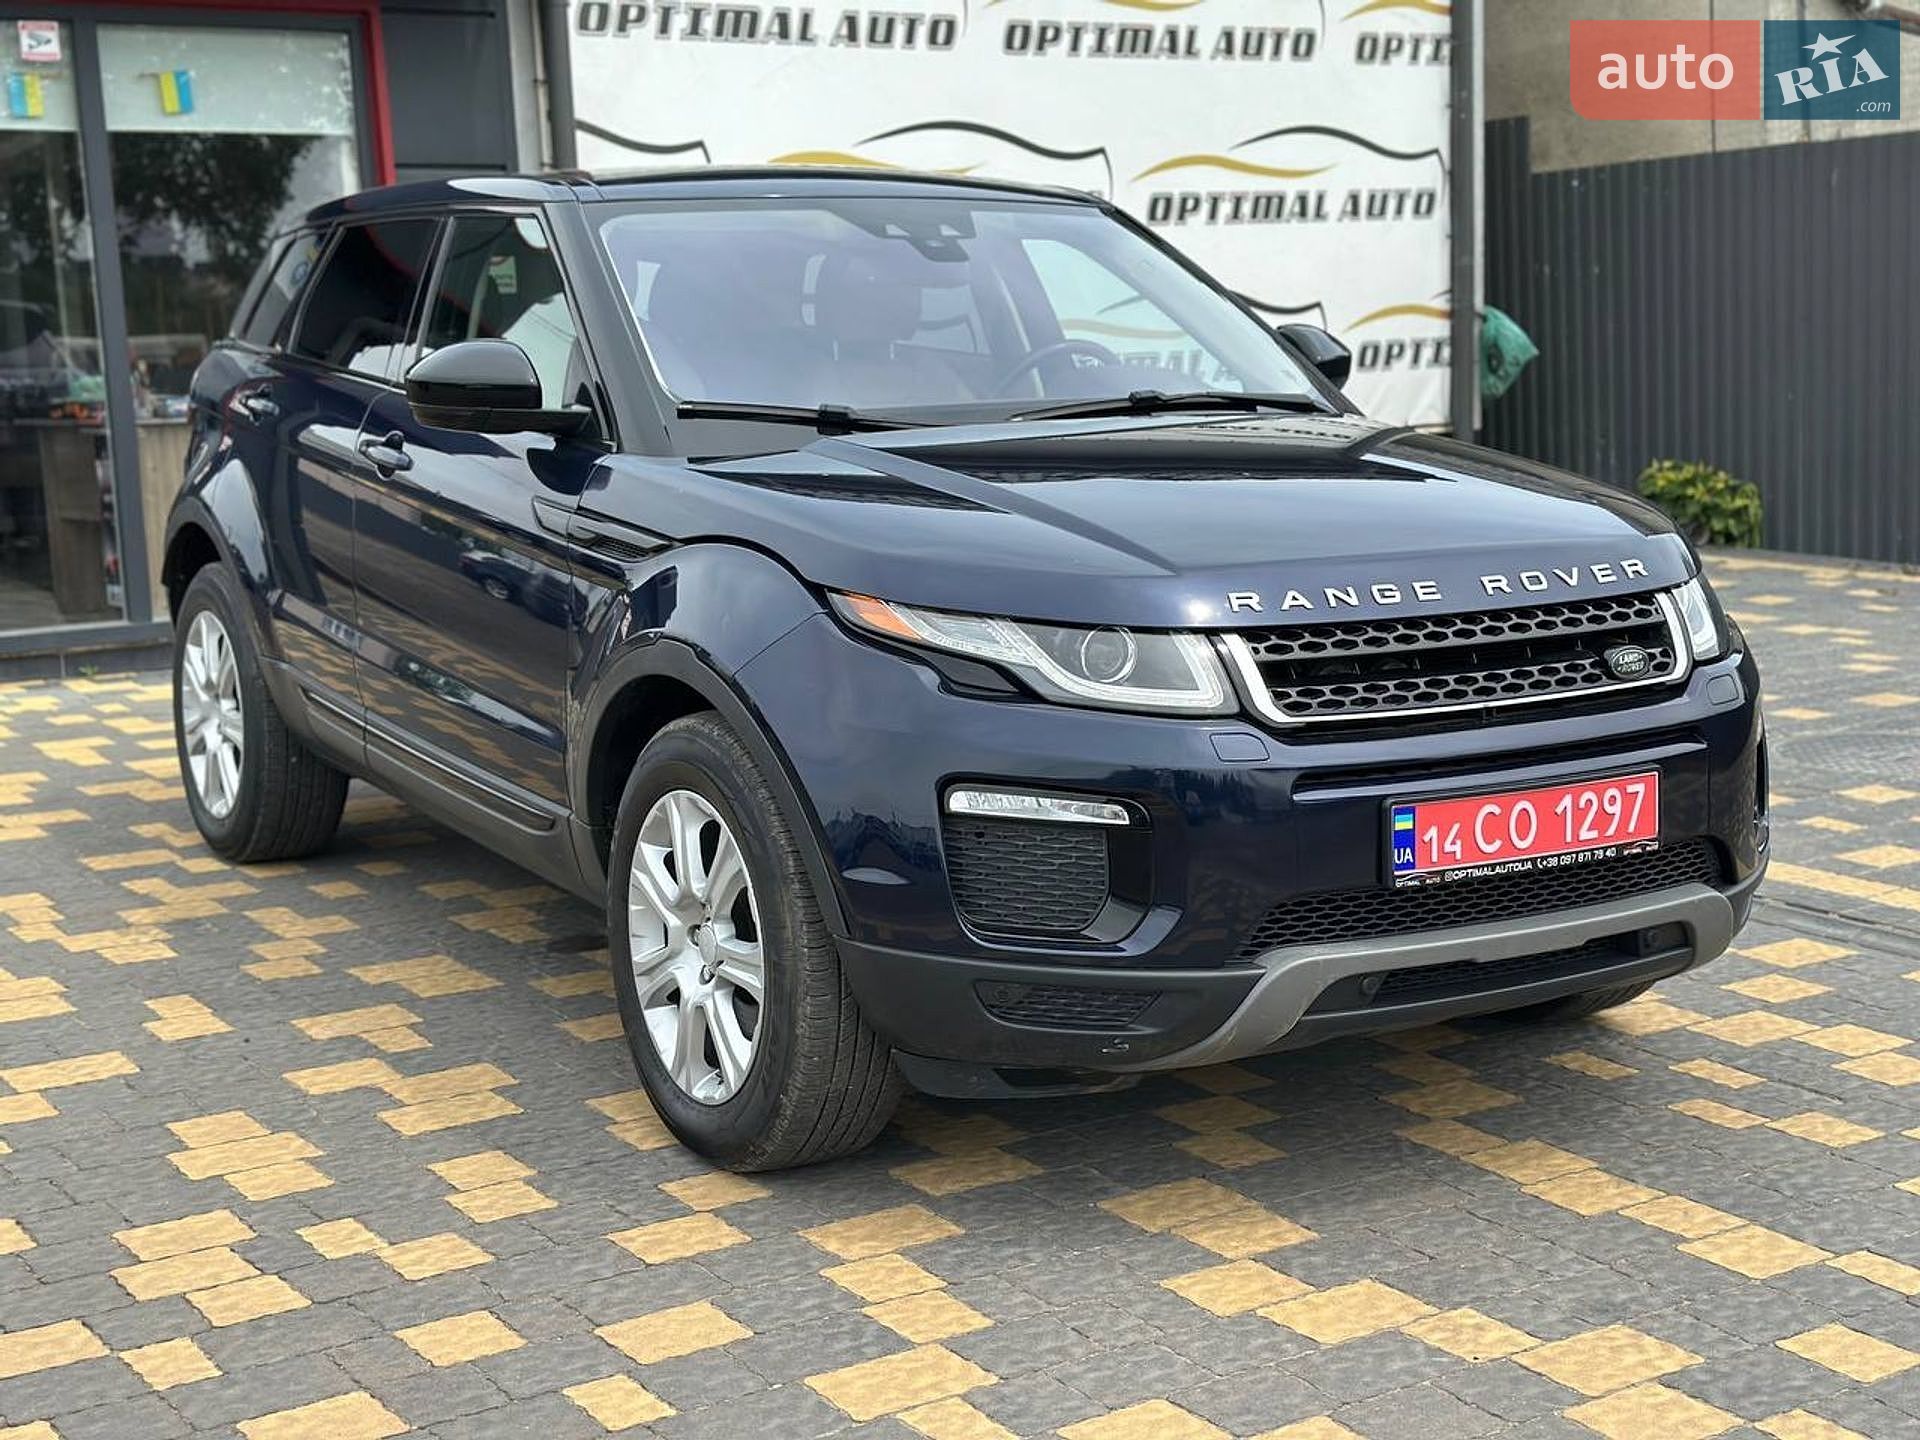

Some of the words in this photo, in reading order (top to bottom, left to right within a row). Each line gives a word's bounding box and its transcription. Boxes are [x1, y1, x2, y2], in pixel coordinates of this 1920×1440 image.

[575, 1, 817, 45] OPTIMAL
[829, 10, 959, 51] AUTO
[1003, 19, 1200, 60] OPTIMAL
[1210, 25, 1317, 62] AUTO
[1148, 190, 1328, 226] OPTIMAL
[1337, 188, 1437, 222] AUTO
[1227, 580, 1441, 613] RANGE
[1479, 558, 1649, 596] ROVER
[1618, 652, 1641, 665] LAND
[1422, 822, 1462, 864] 14
[1474, 799, 1538, 854] CO
[1554, 782, 1646, 843] 1297
[1394, 847, 1414, 864] UA
